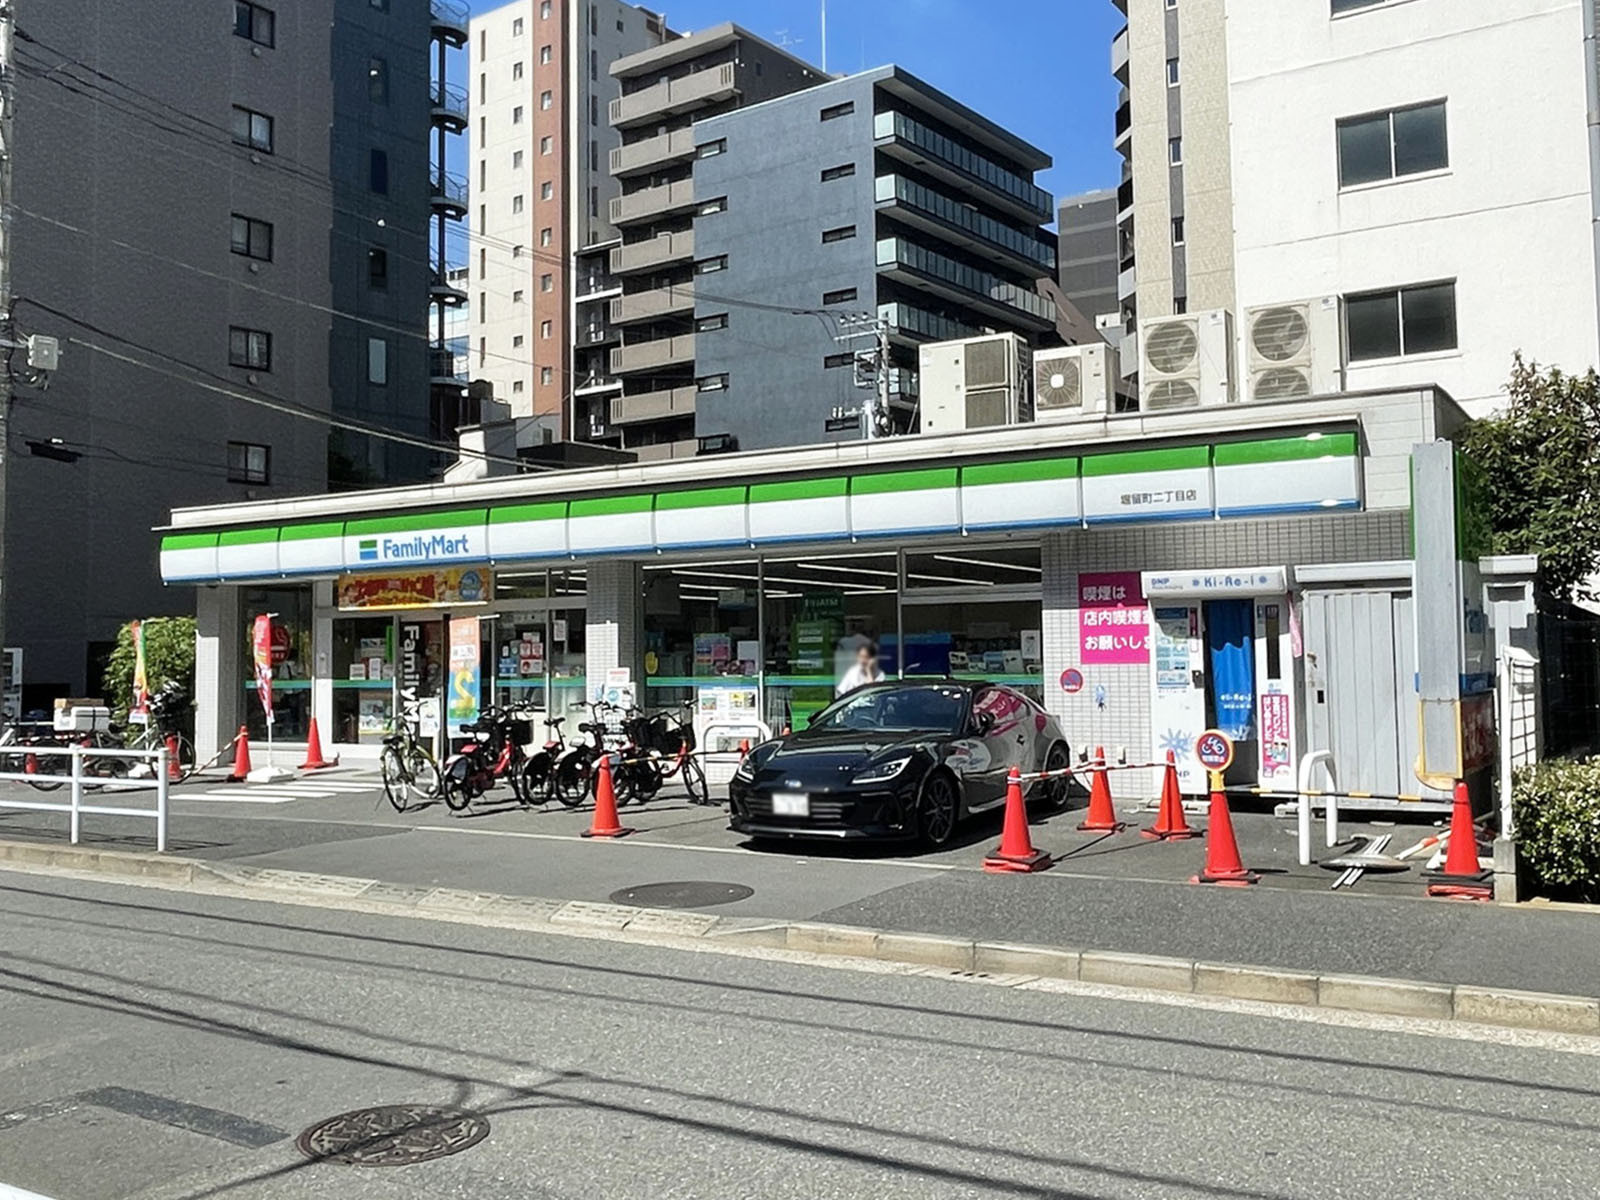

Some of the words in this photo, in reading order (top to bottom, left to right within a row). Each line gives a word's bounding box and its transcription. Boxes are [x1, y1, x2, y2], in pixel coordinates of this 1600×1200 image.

[1120, 489, 1197, 505] 堀留町二丁目店
[383, 534, 470, 559] FamilyMart
[1082, 585, 1127, 602] 喫煙は
